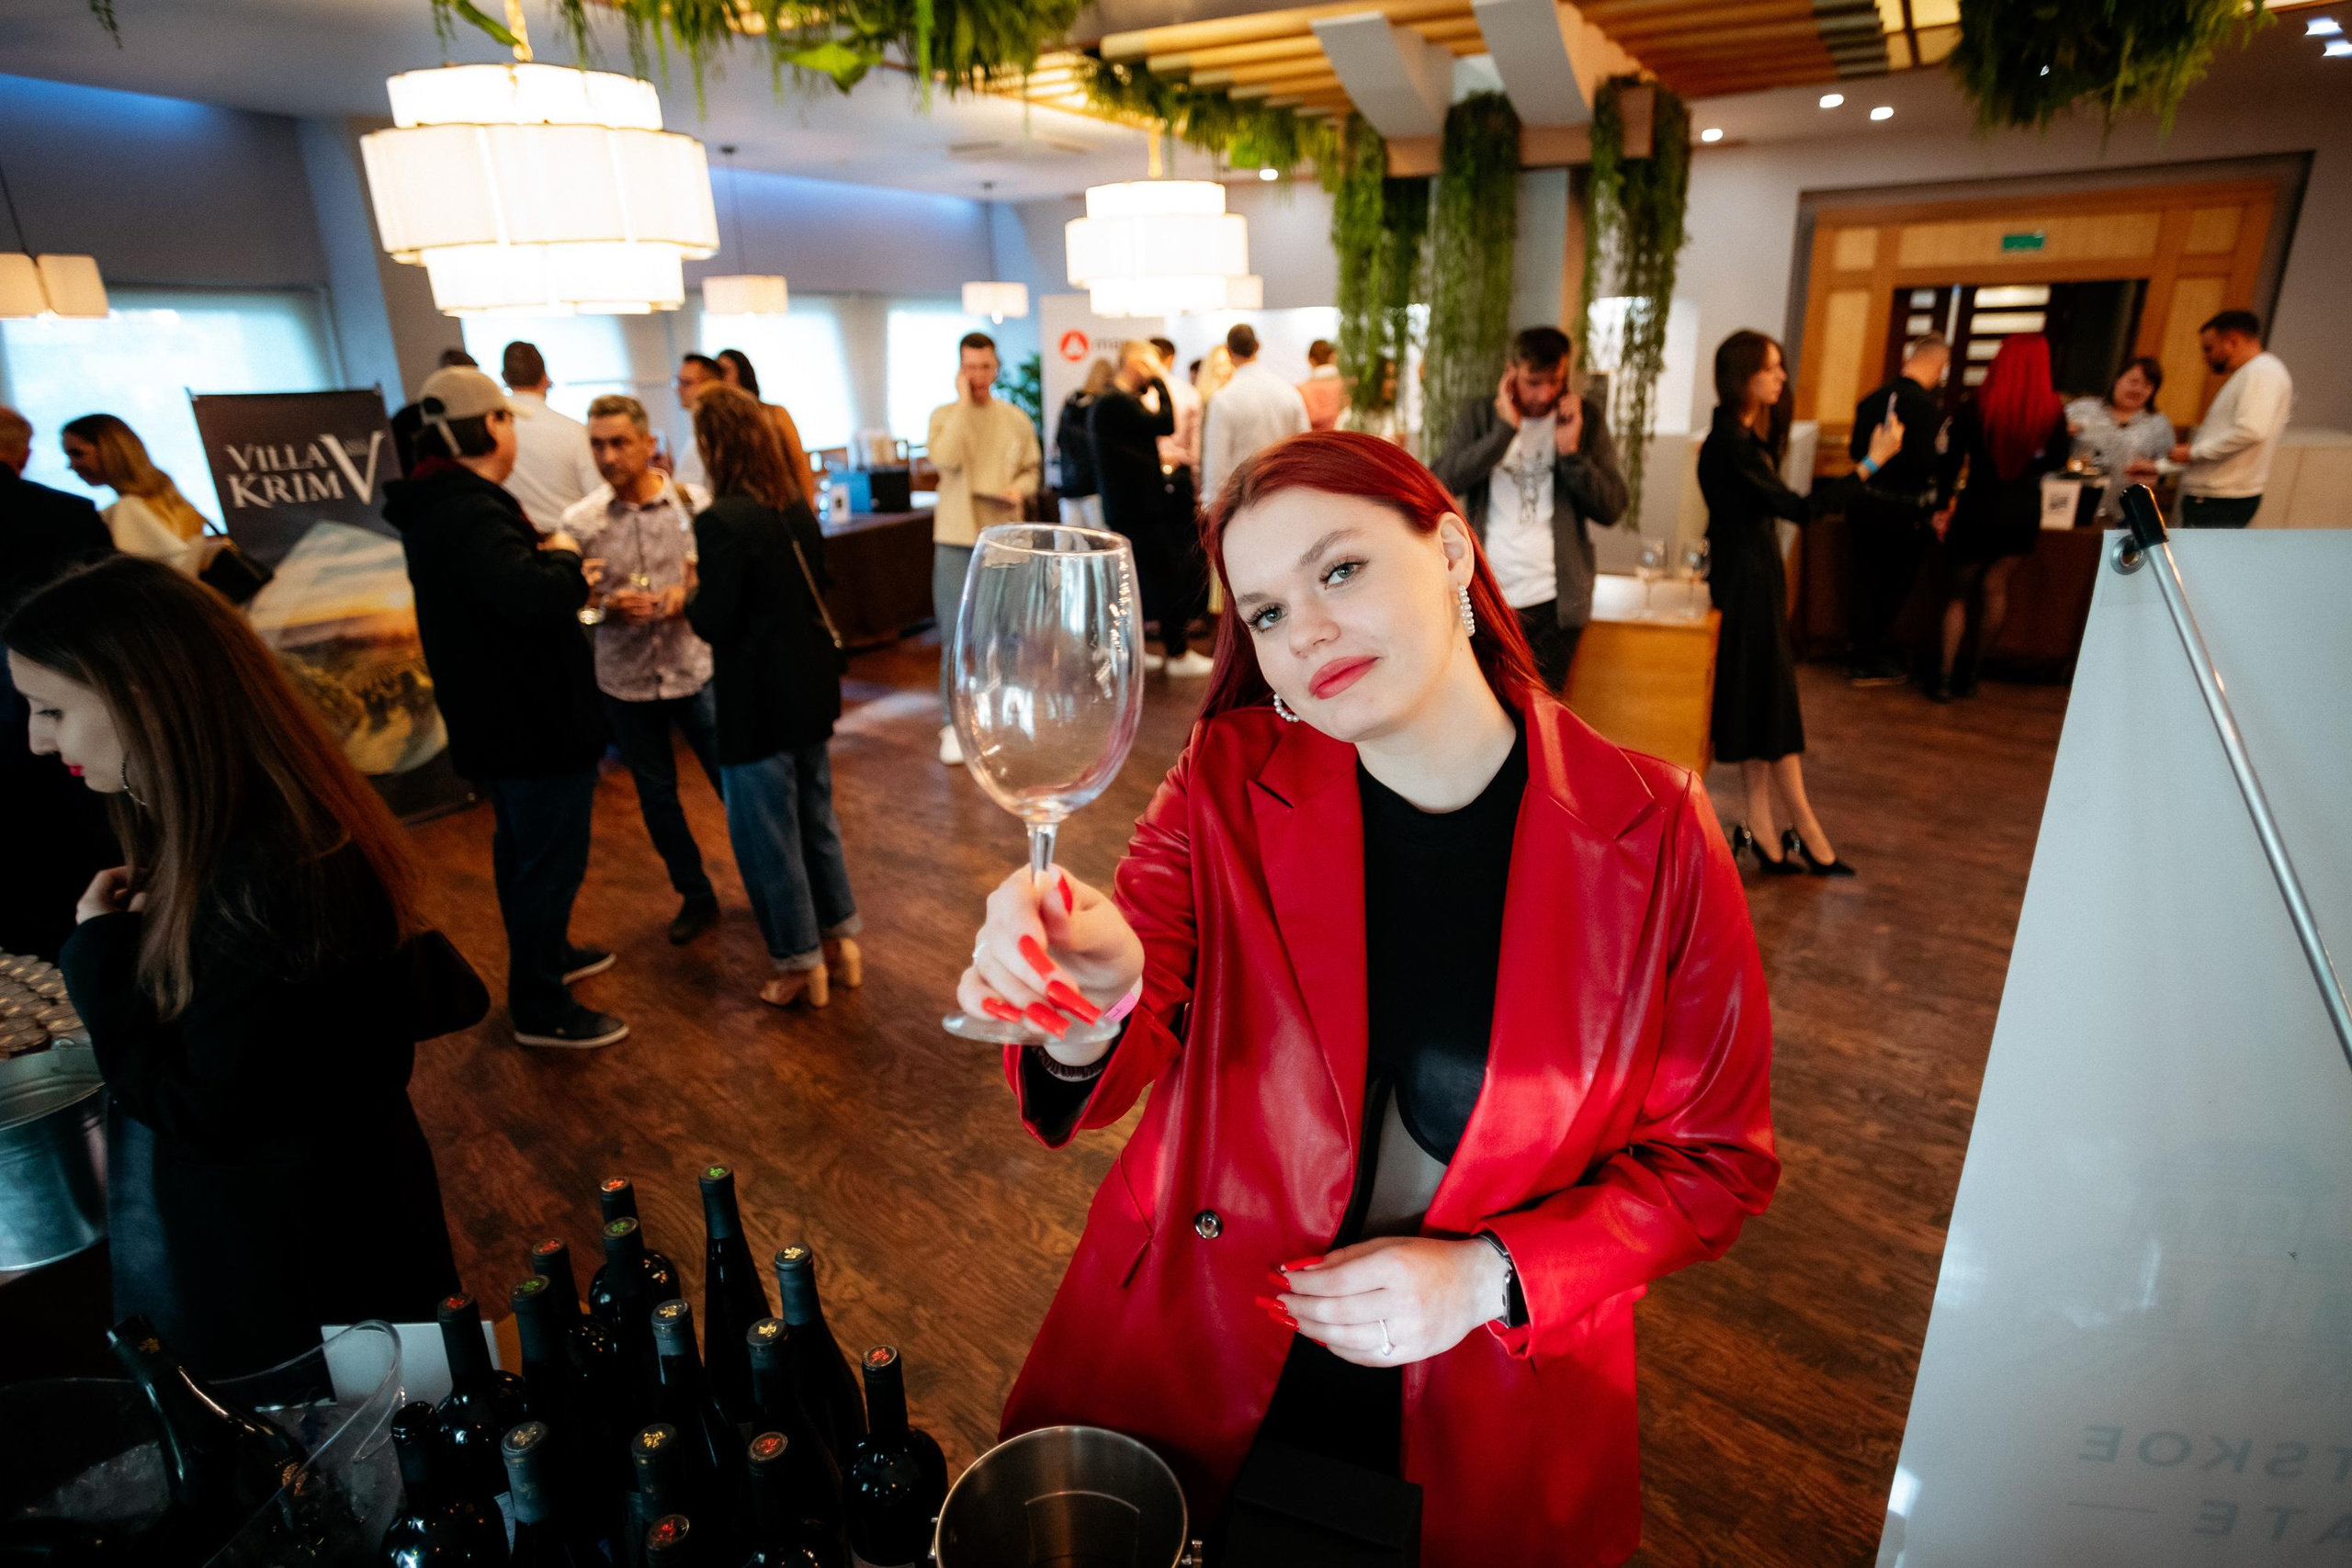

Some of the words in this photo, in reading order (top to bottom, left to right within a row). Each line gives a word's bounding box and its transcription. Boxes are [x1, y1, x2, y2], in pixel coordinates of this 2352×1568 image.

[225, 443, 329, 472] VILLA
[318, 429, 387, 505] V
[228, 469, 345, 509] KRIM
